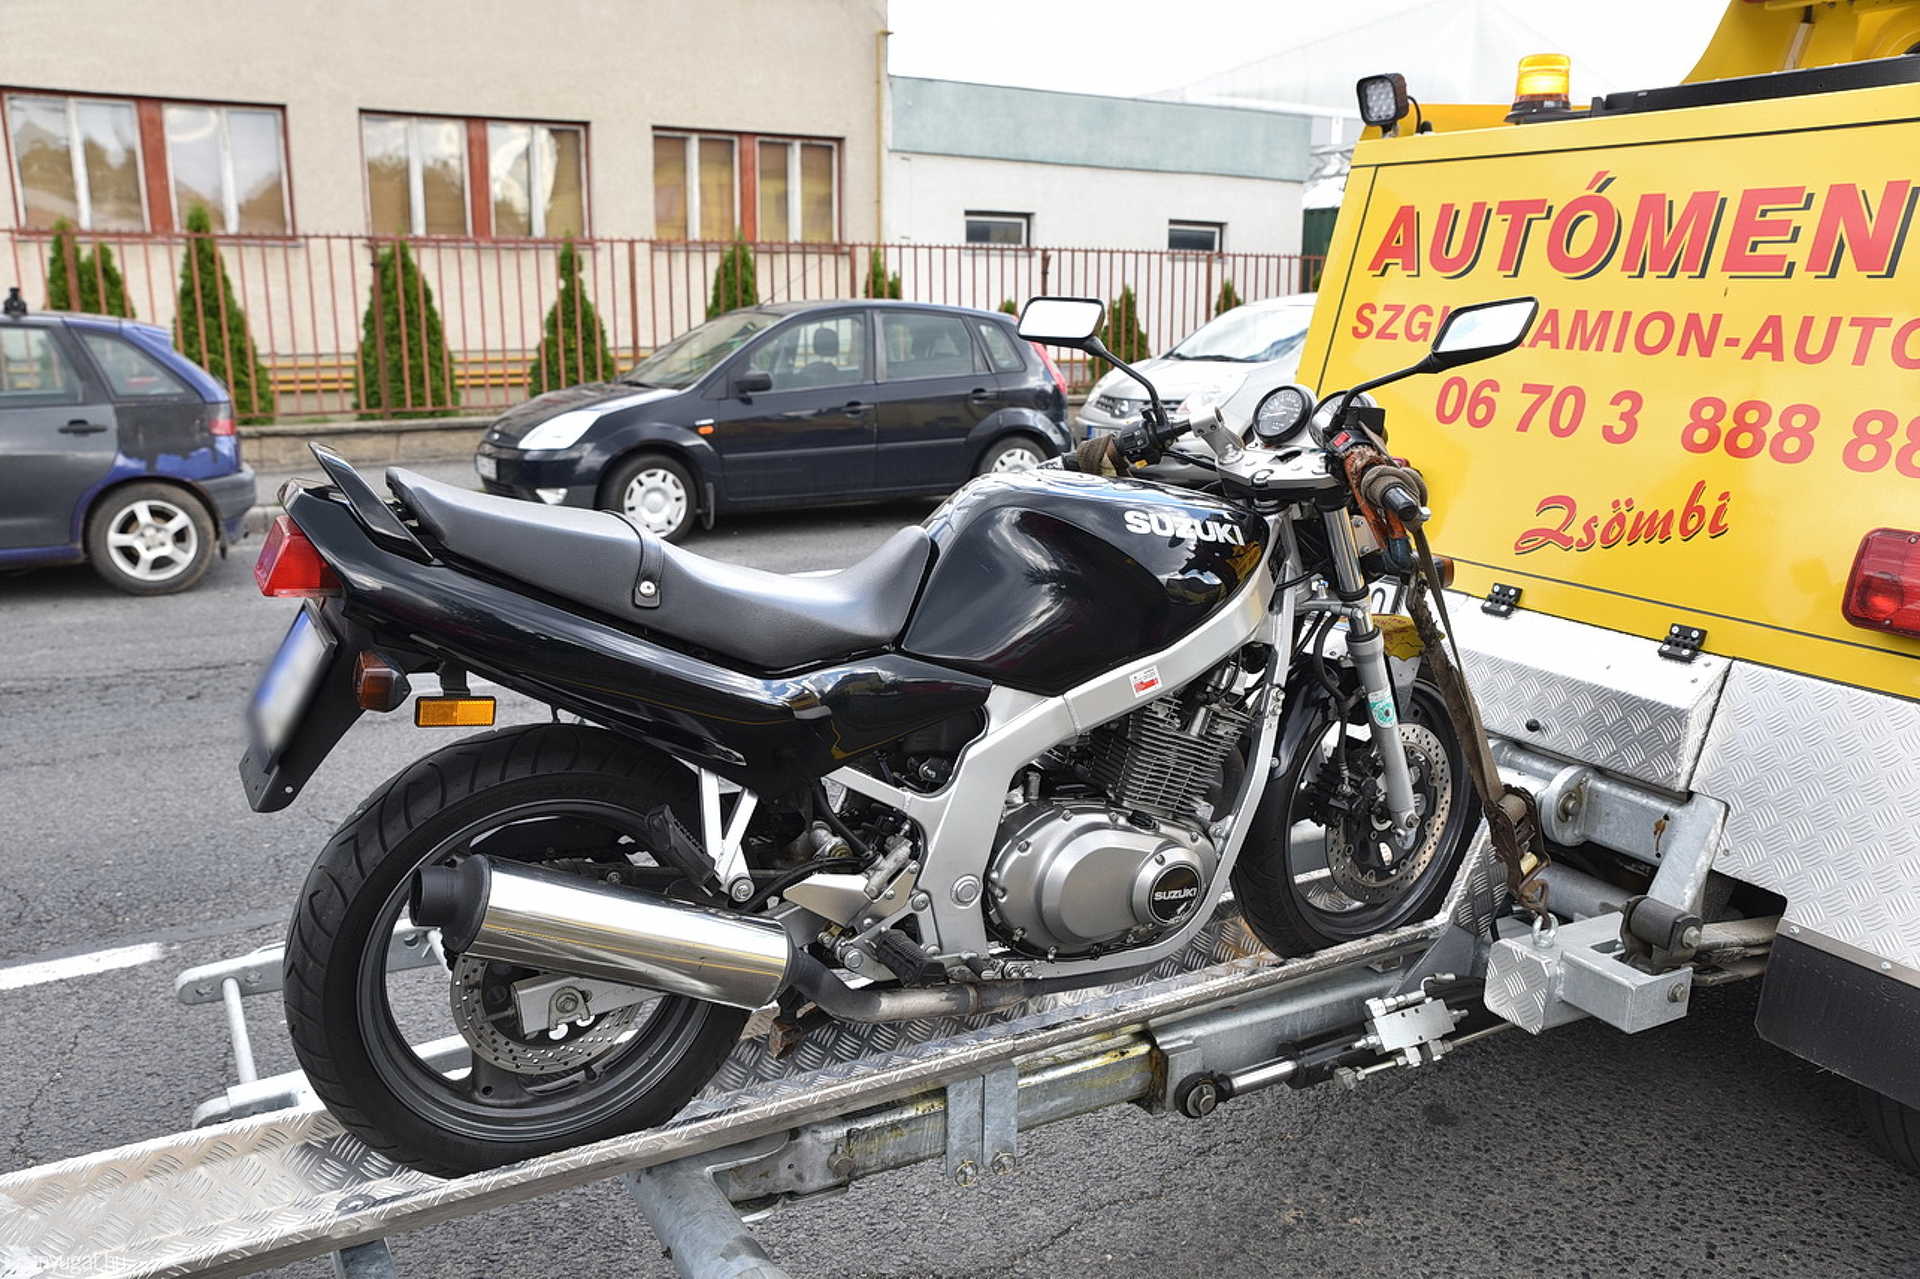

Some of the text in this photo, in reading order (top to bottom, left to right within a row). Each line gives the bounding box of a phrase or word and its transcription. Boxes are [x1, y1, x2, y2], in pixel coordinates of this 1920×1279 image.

[1368, 170, 1920, 280] AUTÓMEN
[1435, 375, 1500, 428] 06
[1515, 382, 1587, 438] 70
[1601, 389, 1644, 445] 3
[1680, 396, 1821, 464] 888
[1123, 509, 1246, 547] SUZUKI
[1153, 887, 1198, 901] SUZUKI
